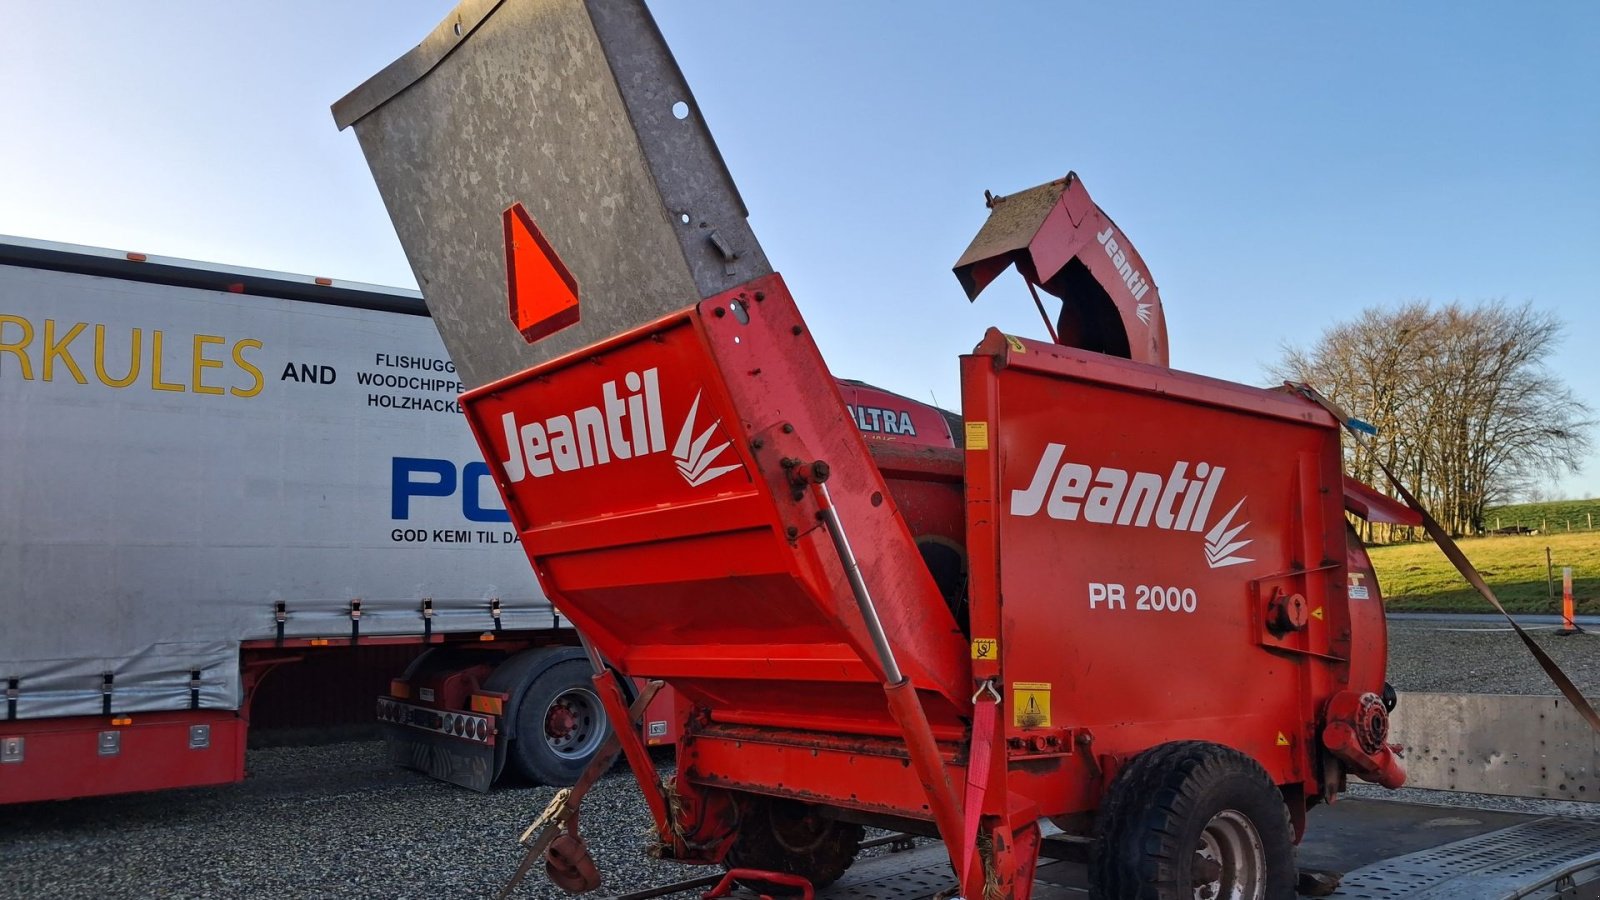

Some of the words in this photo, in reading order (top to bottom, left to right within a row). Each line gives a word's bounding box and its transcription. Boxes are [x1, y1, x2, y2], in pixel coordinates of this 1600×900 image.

[1096, 226, 1150, 301] Jeantil
[0, 314, 265, 398] RKULES
[281, 362, 337, 385] AND
[376, 353, 456, 374] FLISHUGG
[357, 372, 465, 394] WOODCHIPPE
[368, 393, 464, 414] HOLZHACKE
[502, 367, 667, 483] Jeantil
[1010, 442, 1226, 532] Jeantil
[391, 529, 428, 542] GOD
[433, 529, 471, 543] KEMI
[476, 531, 499, 544] TIL
[1088, 582, 1126, 609] PR
[1135, 585, 1197, 613] 2000
